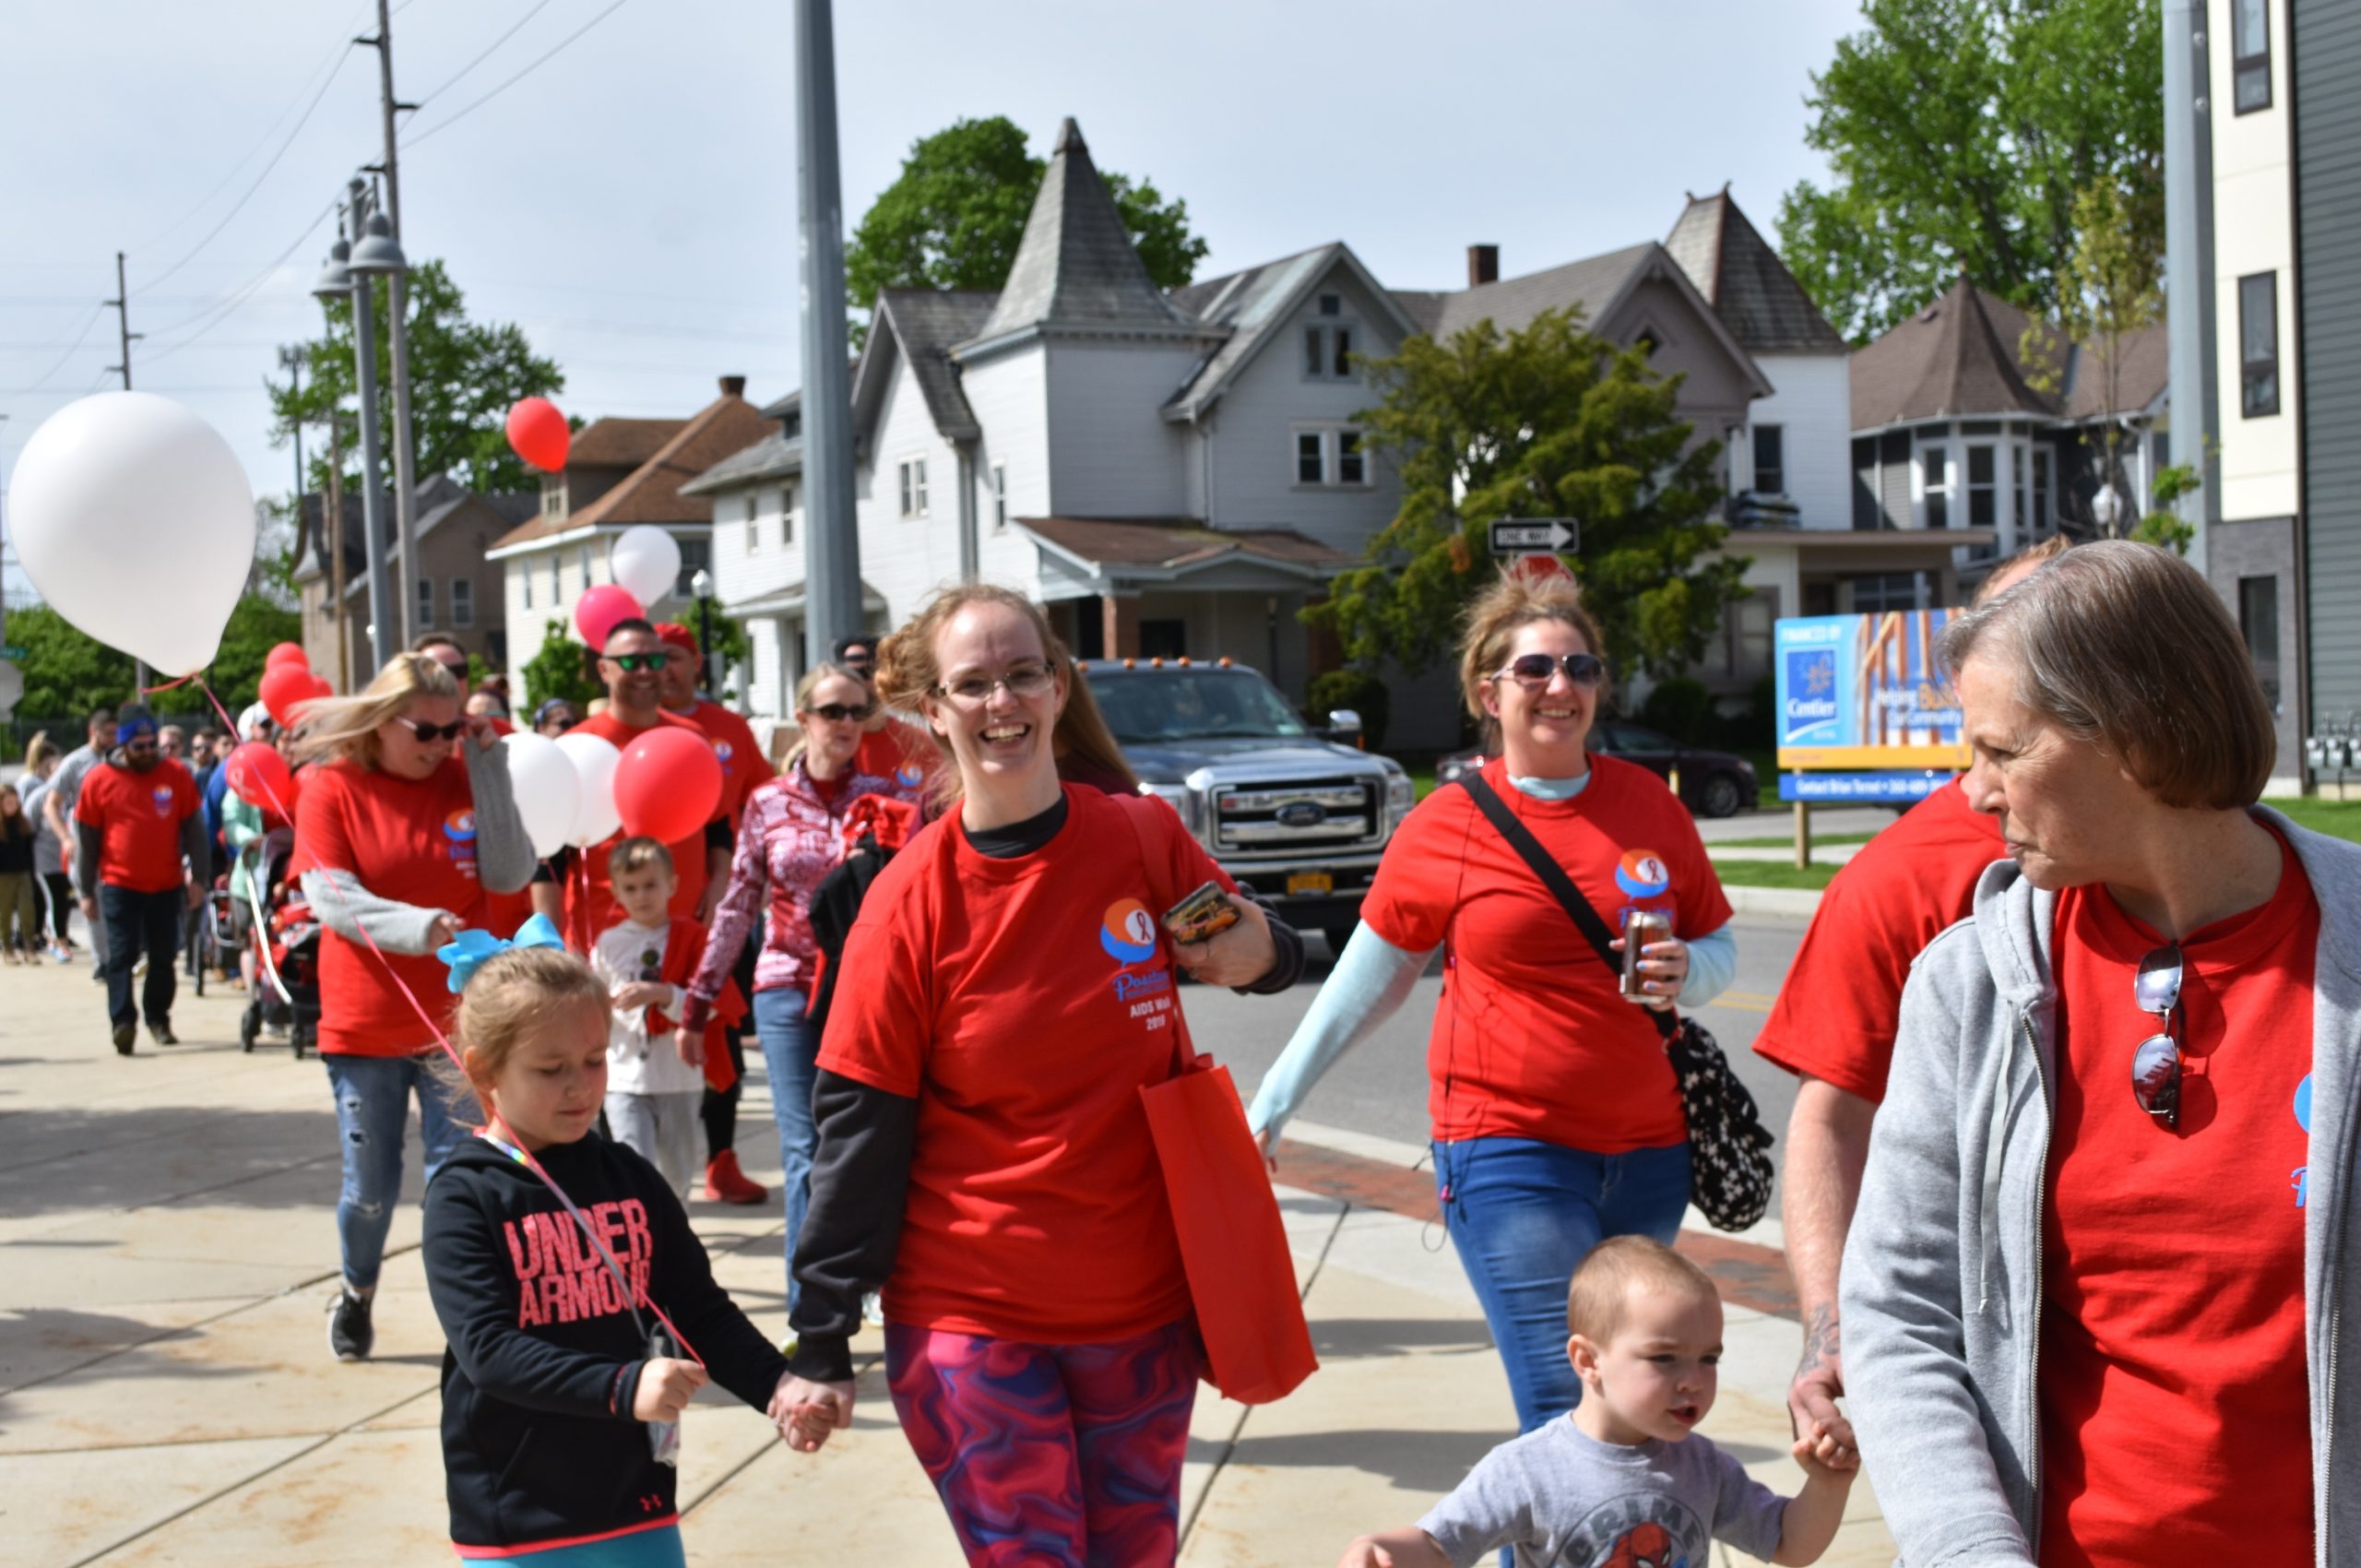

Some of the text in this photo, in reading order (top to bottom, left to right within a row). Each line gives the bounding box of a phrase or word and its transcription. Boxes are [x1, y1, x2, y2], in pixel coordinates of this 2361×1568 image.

[1501, 529, 1549, 542] ONE WAY
[1787, 697, 1836, 718] Centier
[1130, 1000, 1155, 1018] AIDS
[503, 1197, 653, 1280] UNDER
[518, 1258, 651, 1329] ARMOUR
